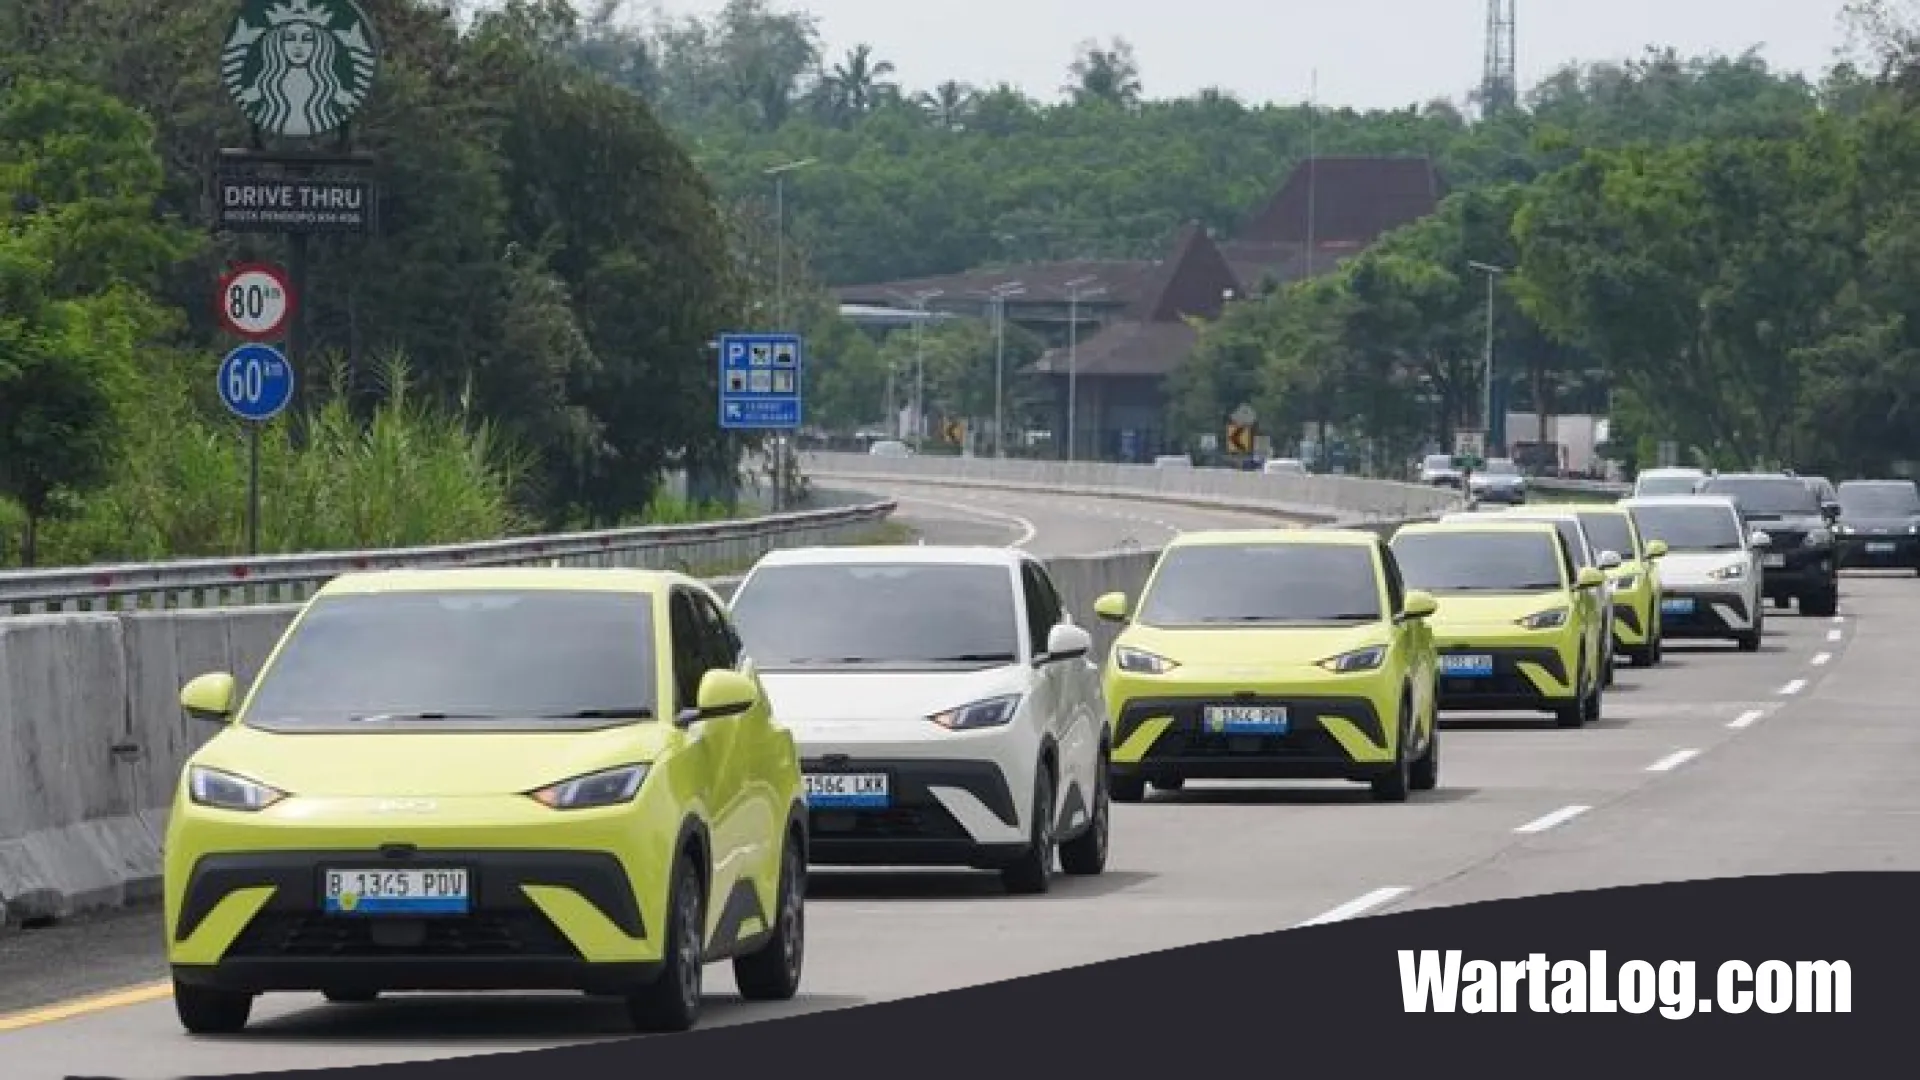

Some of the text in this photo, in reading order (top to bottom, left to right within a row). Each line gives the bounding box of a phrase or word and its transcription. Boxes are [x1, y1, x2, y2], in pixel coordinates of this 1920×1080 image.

[223, 186, 361, 208] DRIVE THRU
[229, 284, 264, 318] 80
[229, 358, 262, 403] 60
[331, 873, 342, 896] B
[423, 873, 463, 897] PDV
